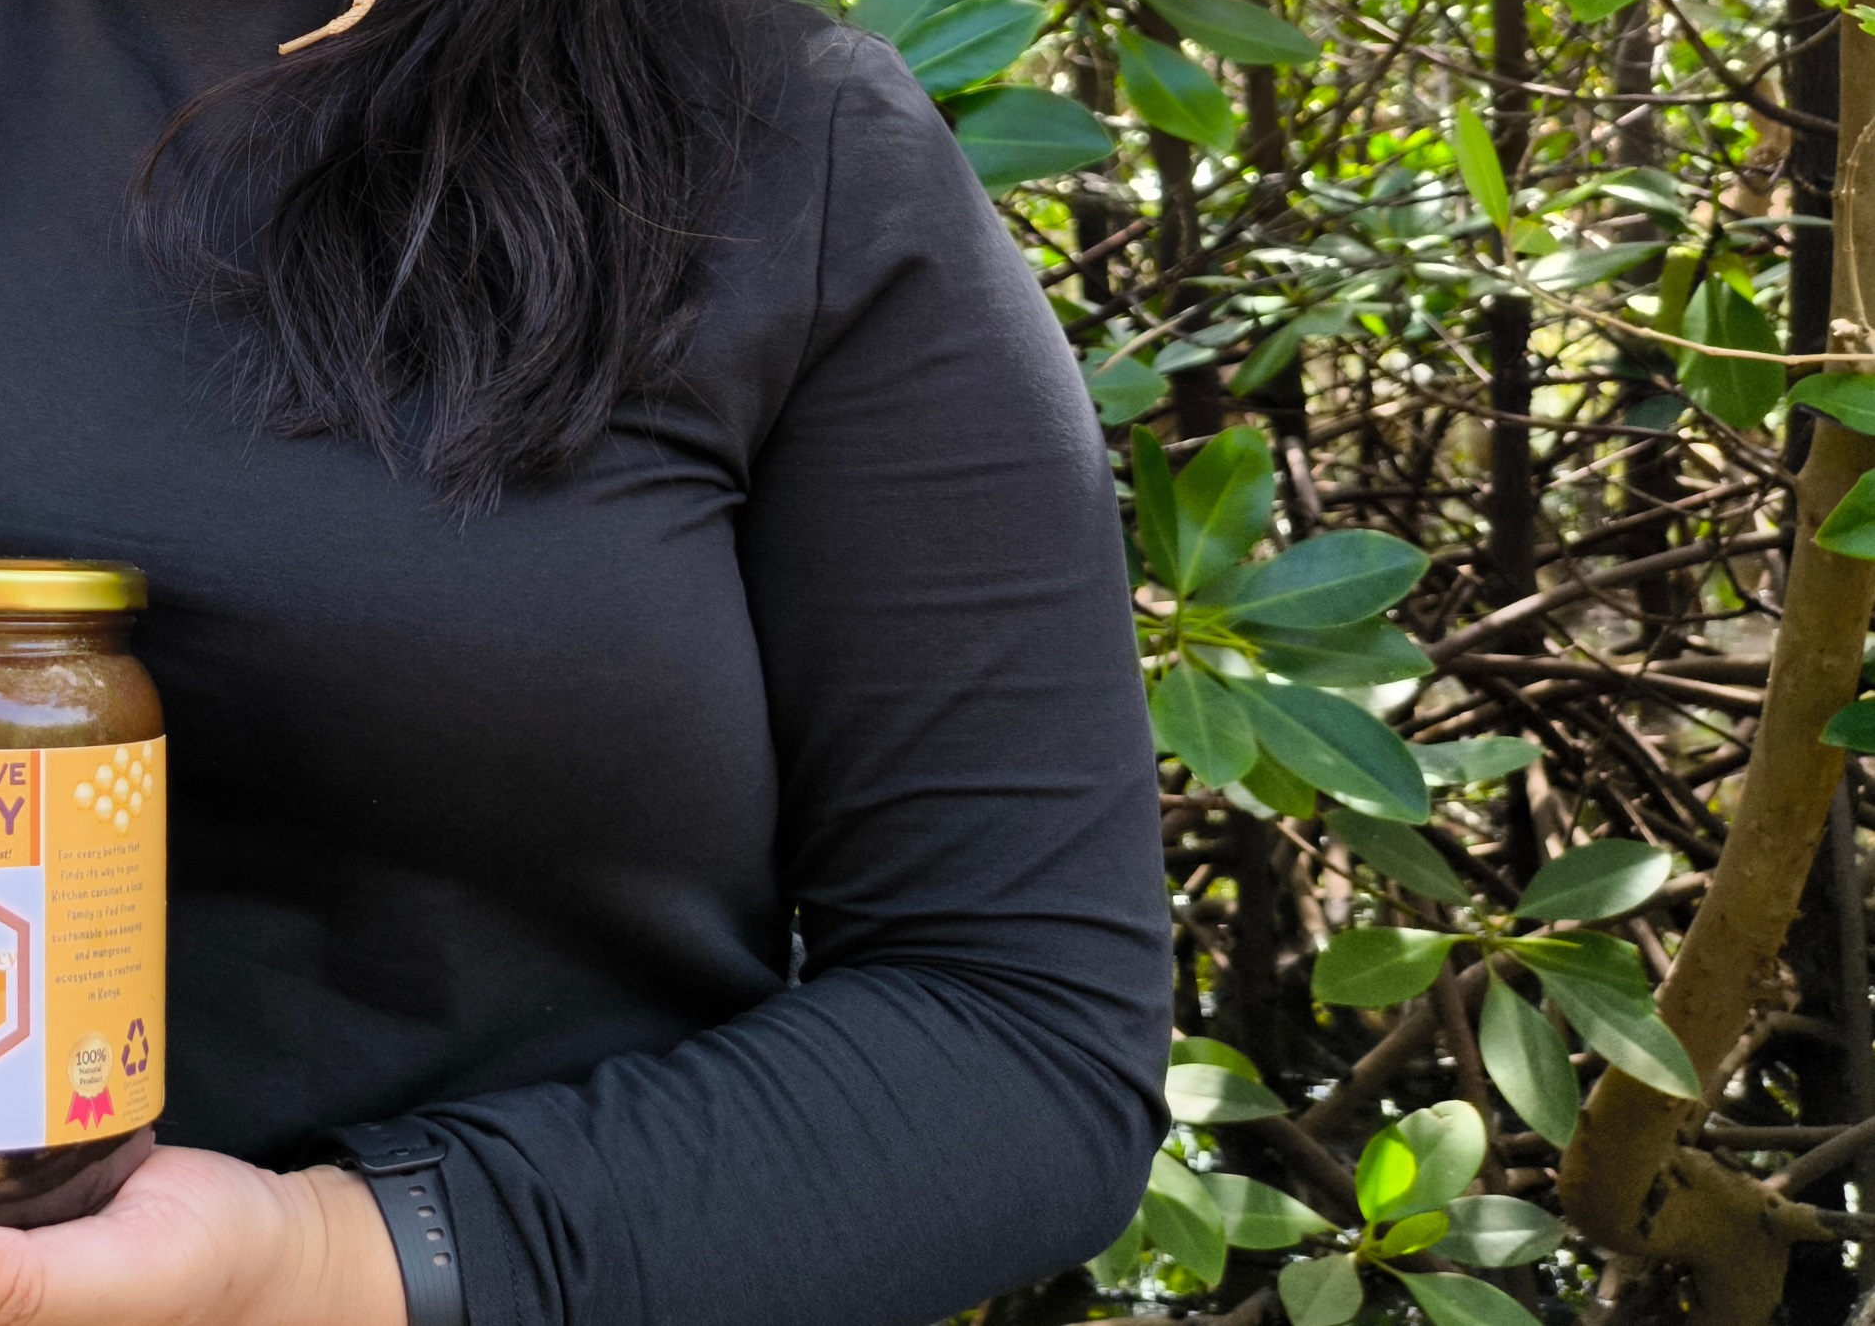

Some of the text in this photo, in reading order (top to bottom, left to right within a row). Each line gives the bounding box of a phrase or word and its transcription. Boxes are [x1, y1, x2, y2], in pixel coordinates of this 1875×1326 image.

[58, 849, 73, 862] For
[76, 850, 101, 860] every
[104, 843, 126, 857] bottle
[60, 868, 84, 880] finds
[86, 867, 98, 878] its
[51, 889, 88, 903] Kitchen
[67, 908, 94, 921] family
[105, 904, 118, 916] fed
[52, 928, 102, 943] sustainable
[74, 949, 90, 961] and
[55, 969, 104, 984] ecosystem
[76, 1047, 107, 1066] 100%
[79, 1064, 102, 1075] Natural
[79, 1075, 103, 1085] Product
